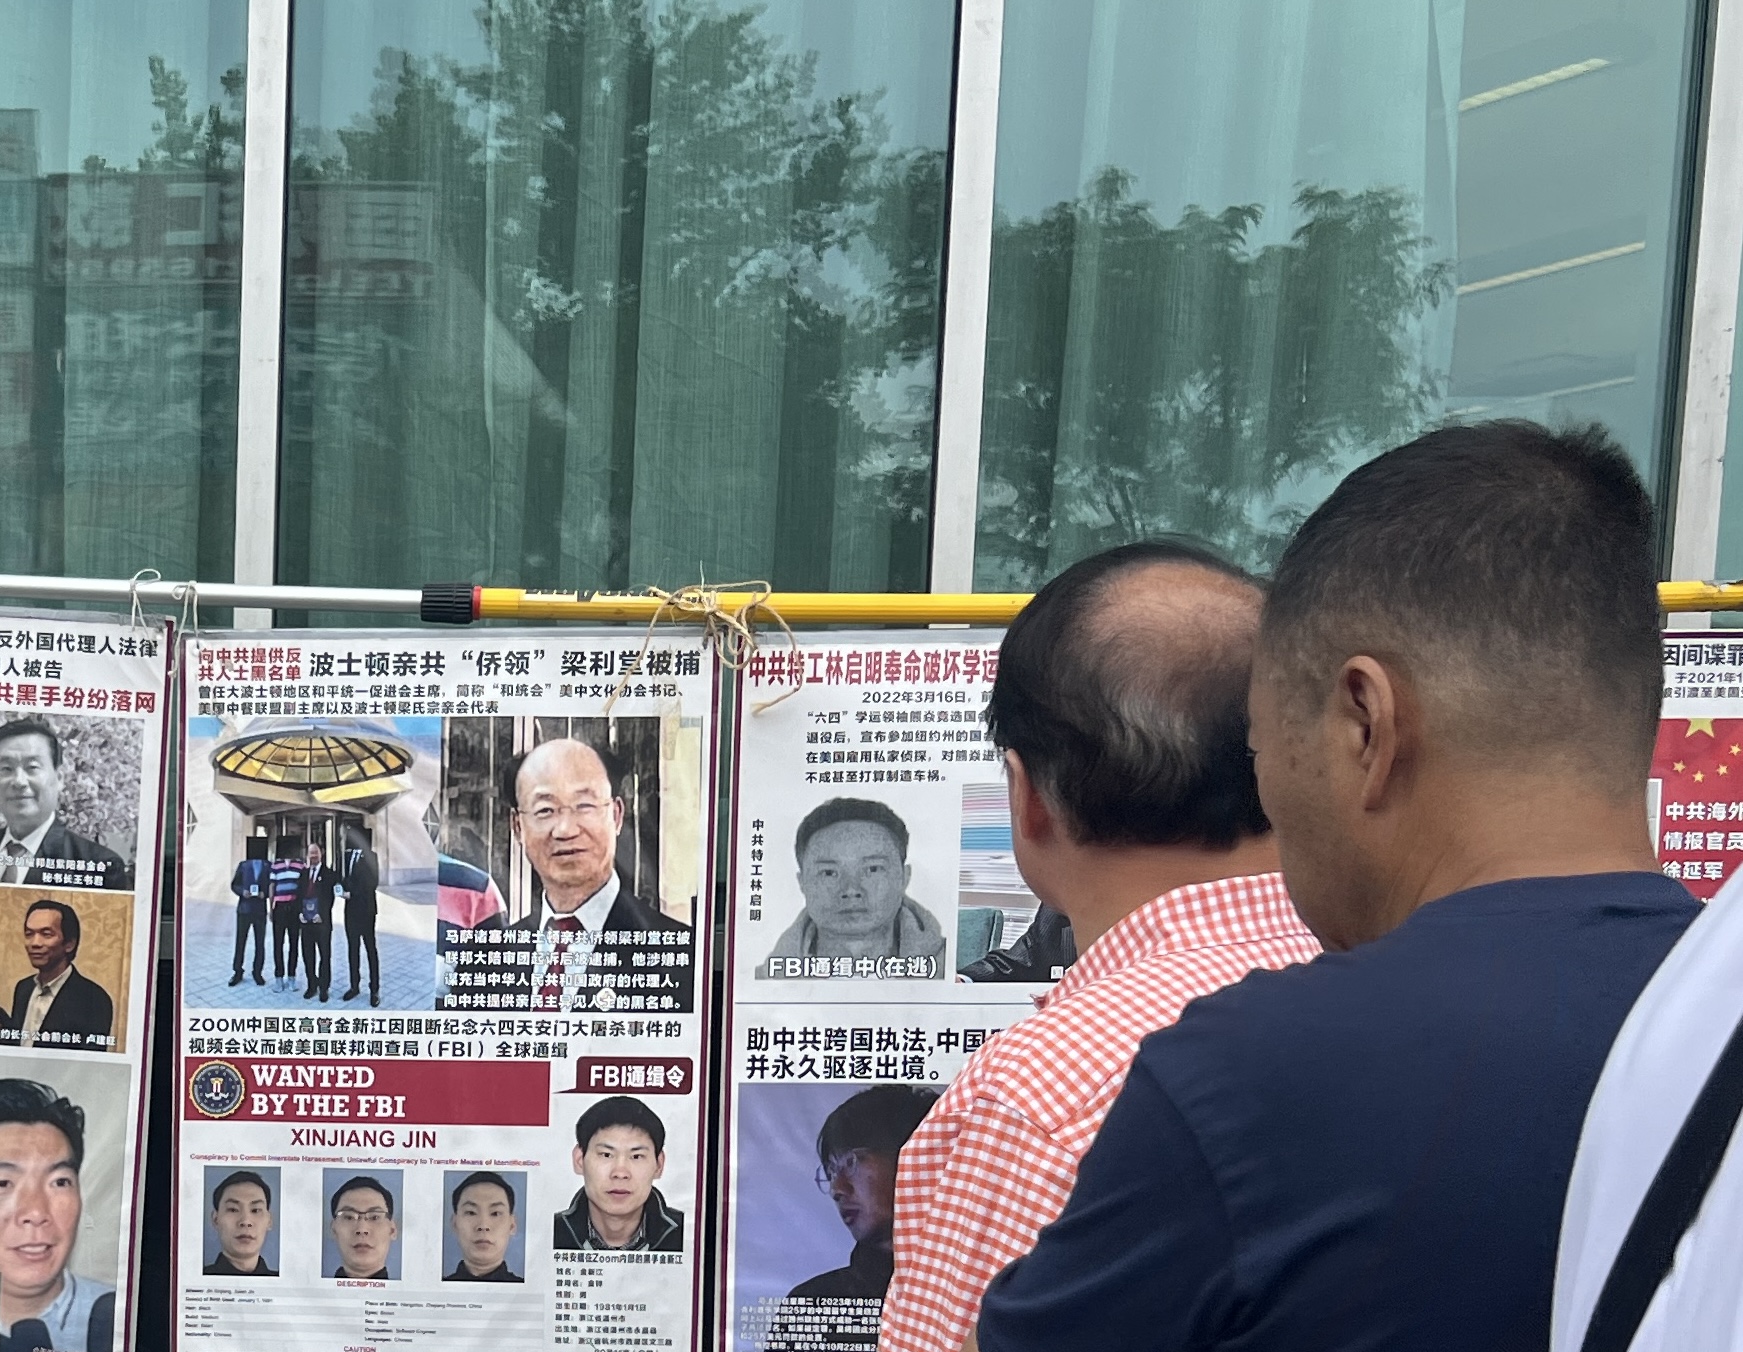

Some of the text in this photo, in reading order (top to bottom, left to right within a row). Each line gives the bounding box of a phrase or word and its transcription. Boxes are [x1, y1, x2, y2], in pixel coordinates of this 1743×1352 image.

[198, 647, 301, 664] 向中共提供反
[198, 665, 302, 681] 共人士黑名单
[42, 872, 104, 886] 秘书长王书君
[749, 819, 765, 921] 中共特工林启明
[768, 955, 938, 979] FBI通缉中(在逃)
[746, 1028, 1003, 1055] 助中共跨国执法,中国
[250, 1064, 375, 1088] WANTED
[589, 1064, 686, 1089] FBI通缉令
[250, 1093, 406, 1118] BY THE FBI
[290, 1128, 437, 1149] XINJIANG JIN
